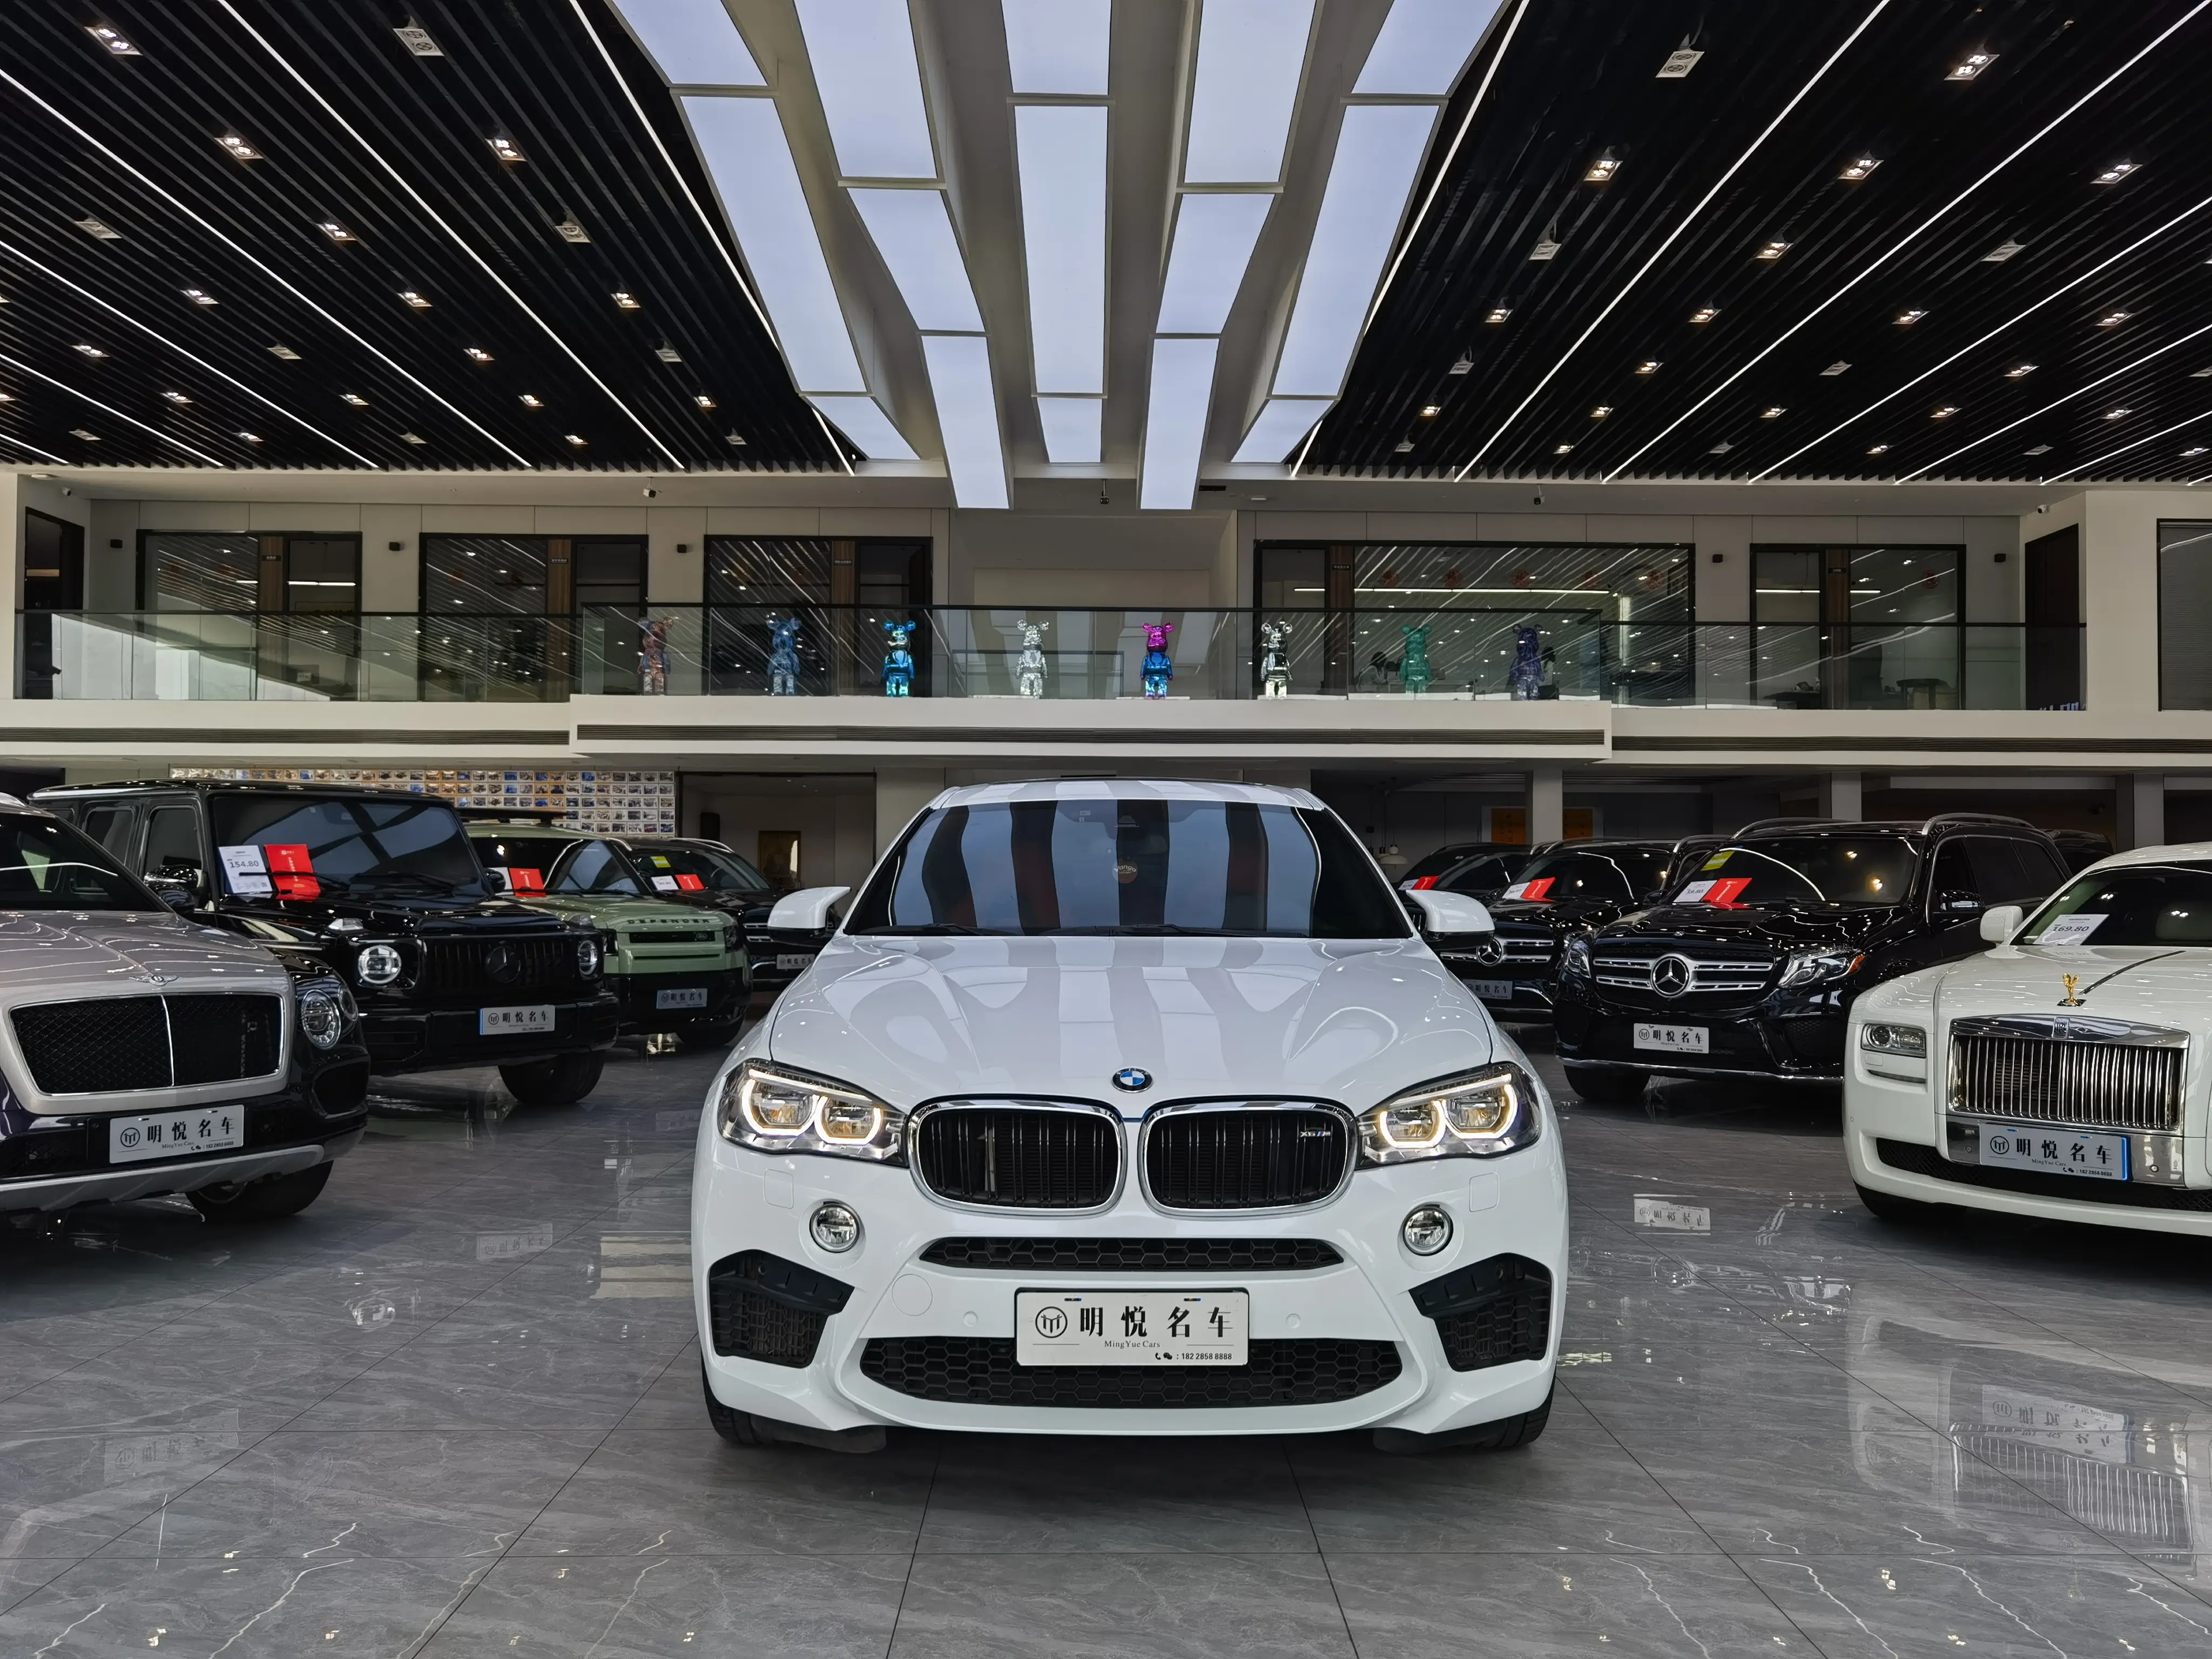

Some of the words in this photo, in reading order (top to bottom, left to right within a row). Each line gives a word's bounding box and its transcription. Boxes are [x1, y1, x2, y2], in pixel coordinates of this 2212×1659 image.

[230, 860, 259, 868] 154.80
[1653, 1029, 1704, 1044] 明悦名车
[147, 1116, 234, 1143] 明悦名车
[2016, 1138, 2113, 1164] 明悦名车
[1080, 1306, 1233, 1338] 明悦名车
